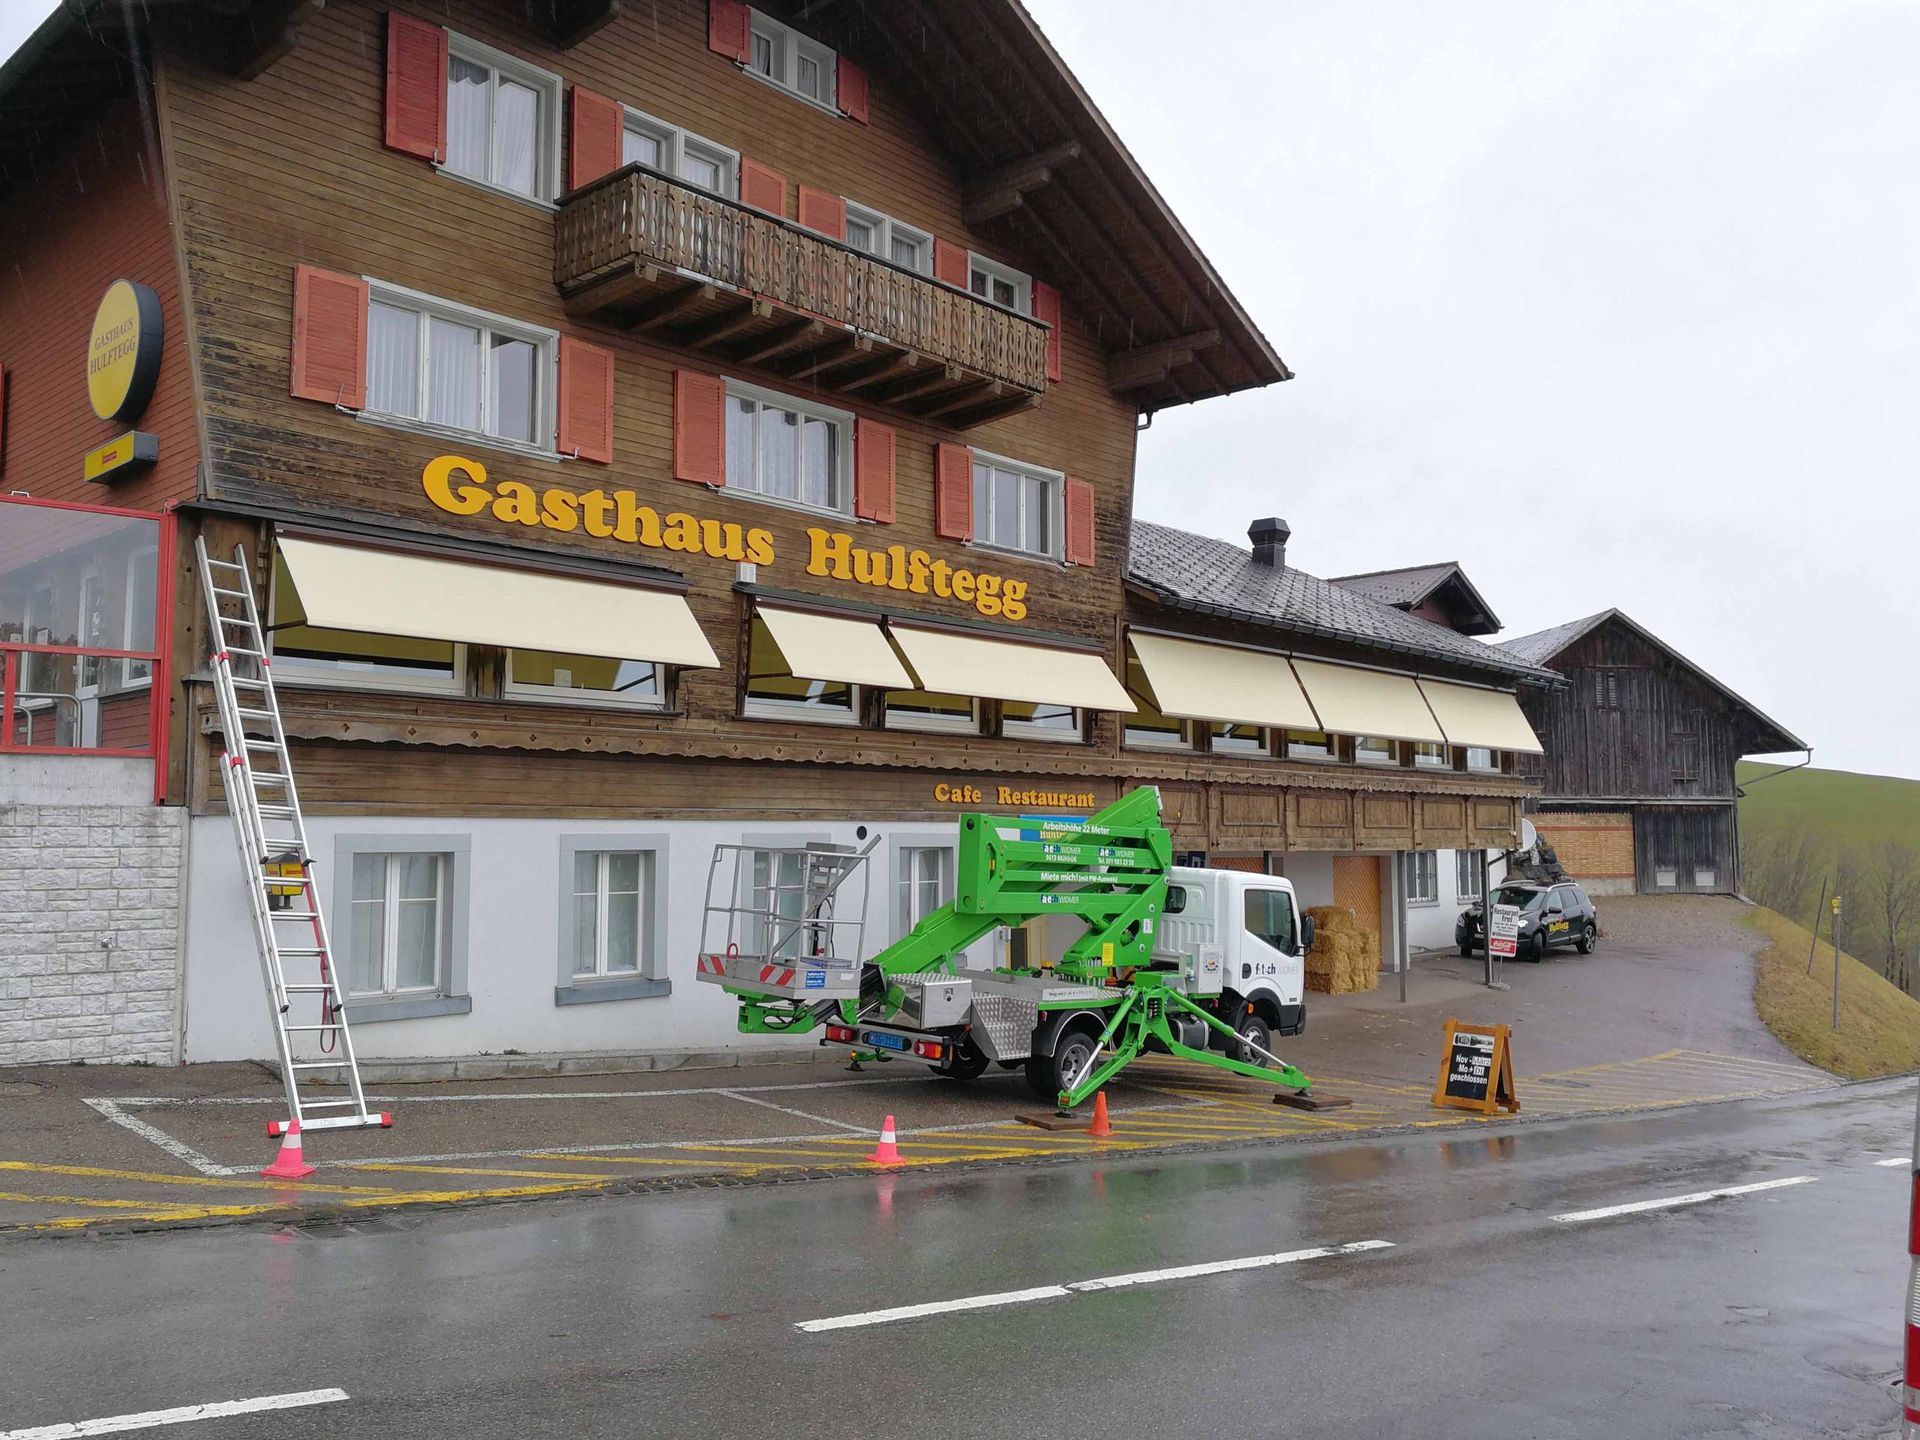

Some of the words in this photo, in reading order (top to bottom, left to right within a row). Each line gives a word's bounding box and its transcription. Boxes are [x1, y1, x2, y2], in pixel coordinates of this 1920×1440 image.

[94, 317, 134, 351] GASTHAUS
[90, 335, 136, 376] HULFTEGG
[421, 454, 775, 567] Gasthaus
[805, 526, 1028, 622] Hulftegg
[934, 783, 982, 803] Cafe
[997, 786, 1096, 808] Restaurant
[1043, 822, 1082, 833] Arbeitshöhe
[1091, 825, 1110, 834] Meter
[1041, 872, 1060, 881] Miete
[1494, 907, 1519, 917] Restaurant
[1456, 1054, 1469, 1063] Nov
[1458, 1064, 1468, 1072] Mo
[1450, 1073, 1488, 1084] geschlossen
